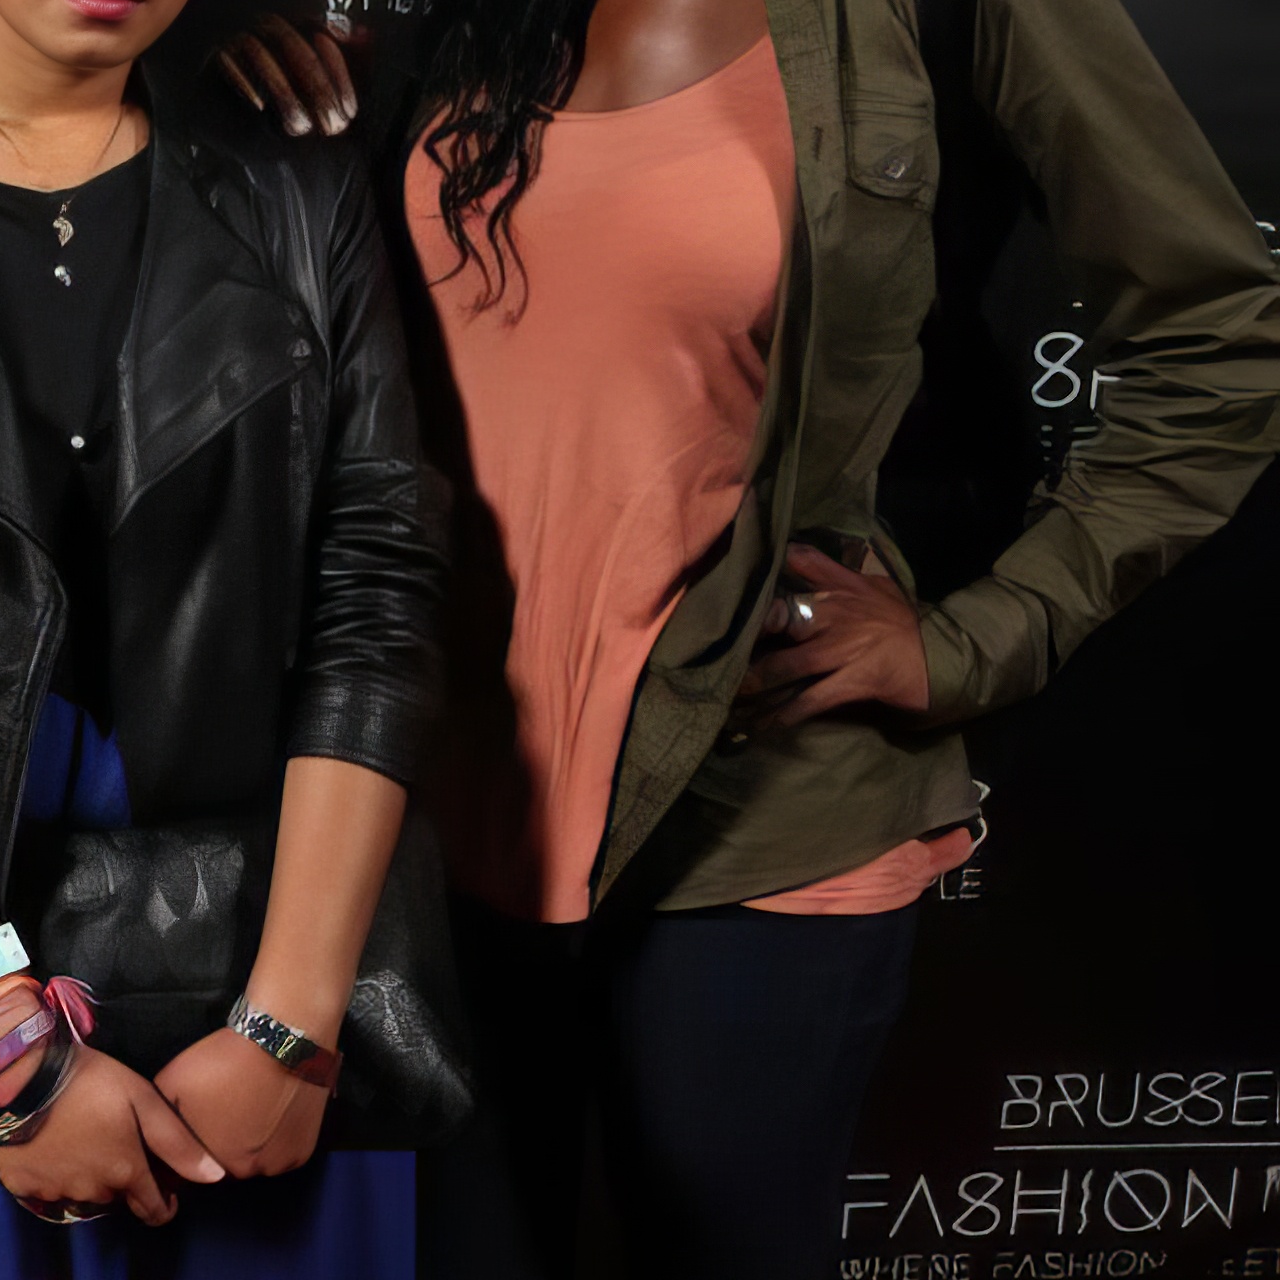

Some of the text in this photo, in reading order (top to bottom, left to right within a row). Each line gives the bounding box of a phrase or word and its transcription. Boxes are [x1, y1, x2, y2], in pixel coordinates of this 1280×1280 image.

[1000, 1070, 1280, 1130] BRUSSE
[841, 1167, 1239, 1239] FASHION
[992, 1249, 1167, 1280] FASHION
